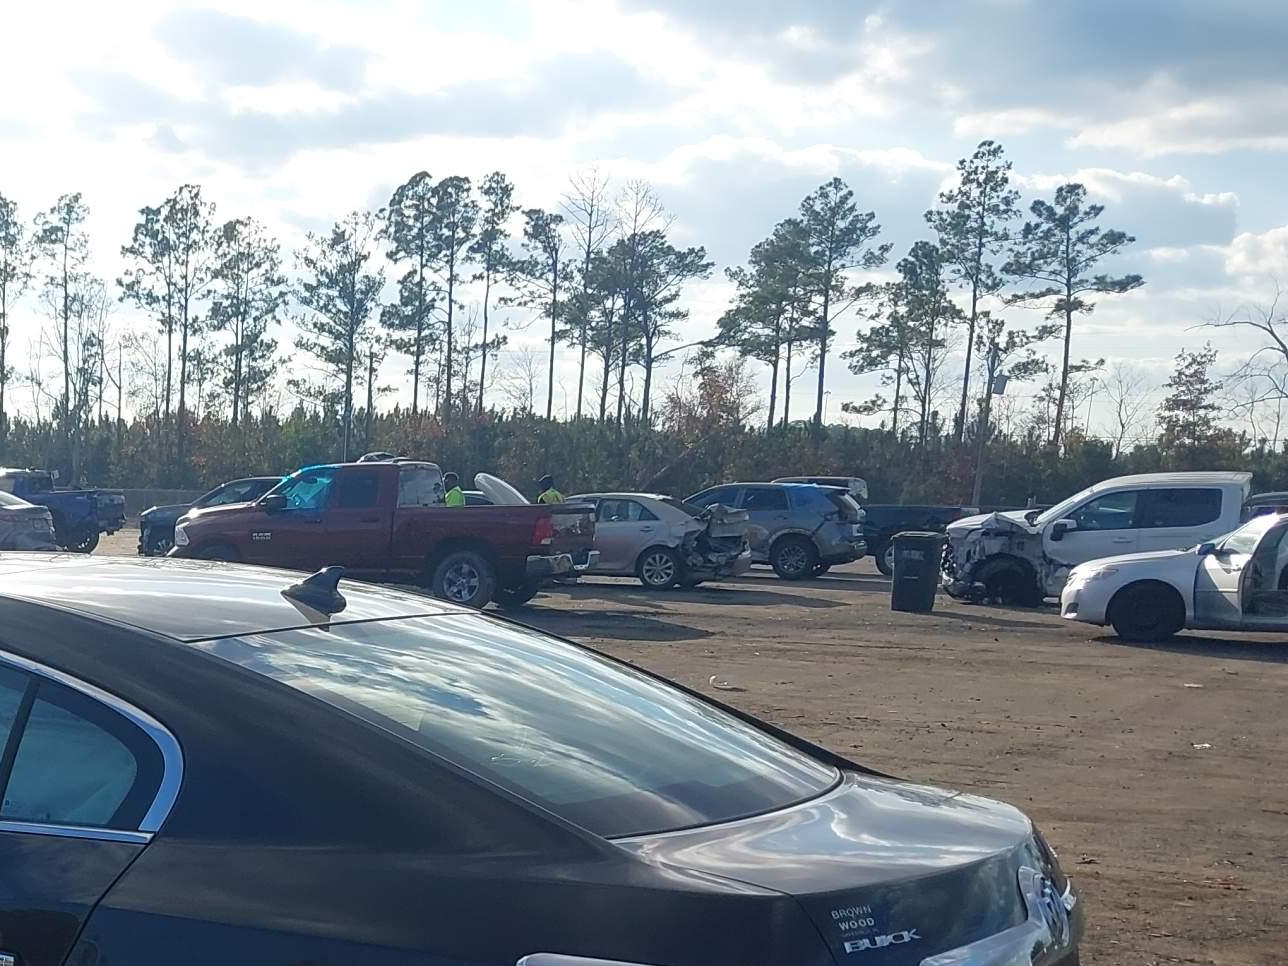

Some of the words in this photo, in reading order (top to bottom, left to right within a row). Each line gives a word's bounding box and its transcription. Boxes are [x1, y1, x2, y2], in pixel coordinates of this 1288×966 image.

[831, 904, 872, 920] BROWN
[838, 917, 875, 931] WOOD
[843, 928, 921, 953] BUICK
